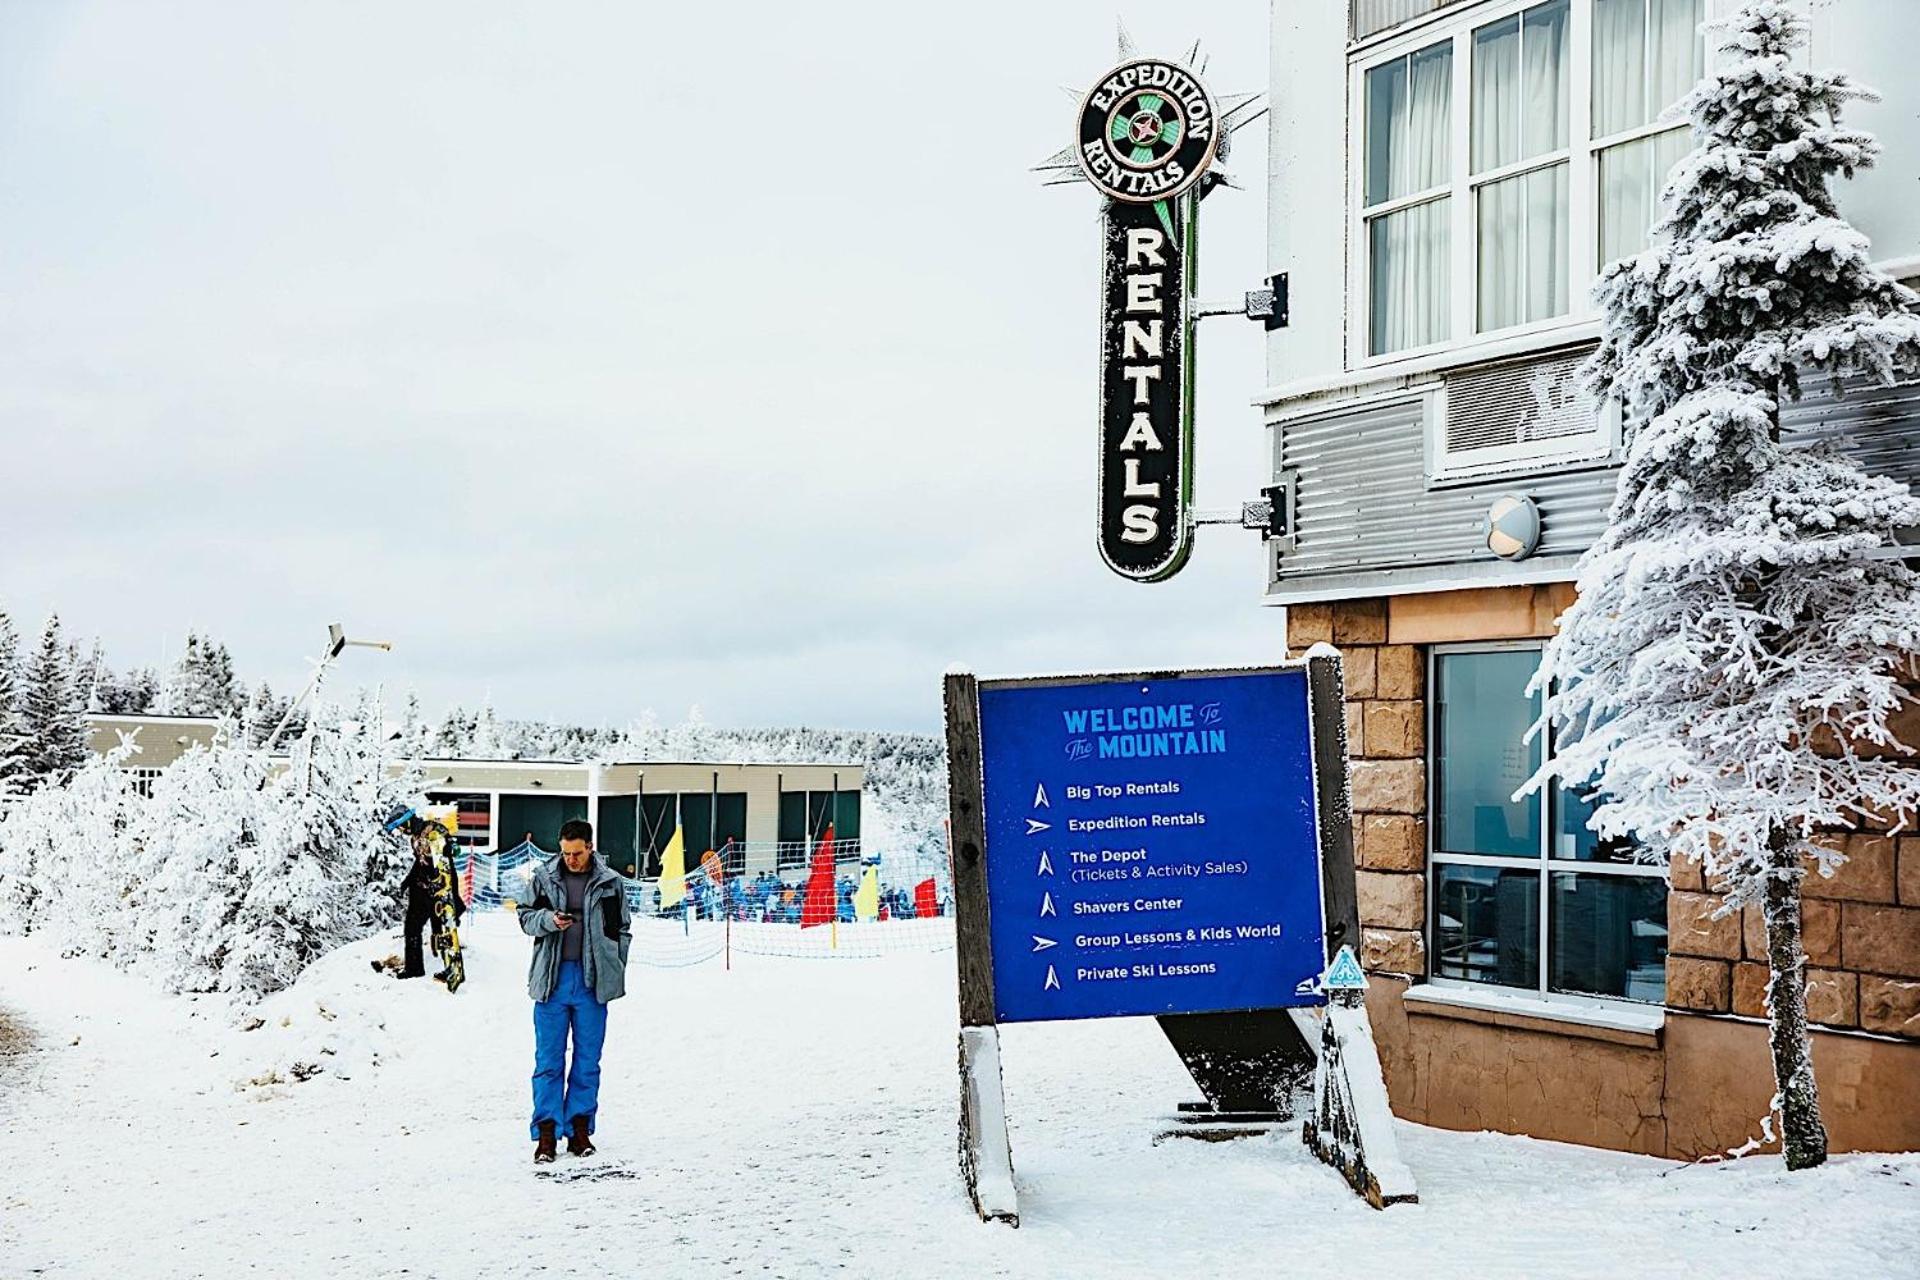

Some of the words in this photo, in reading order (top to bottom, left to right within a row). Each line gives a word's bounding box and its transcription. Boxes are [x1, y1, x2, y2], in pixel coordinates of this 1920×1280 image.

[1091, 65, 1212, 141] EXPEDITION
[1083, 138, 1185, 194] RENTALS
[1119, 228, 1167, 544] RENTALS
[1063, 704, 1195, 734] WELCOME
[1200, 702, 1223, 726] To
[1065, 738, 1094, 761] The
[1098, 730, 1227, 759] MOUNTAIN
[1067, 786, 1091, 800] Big
[1095, 785, 1122, 798] Top
[1126, 781, 1180, 795] Rentals
[1068, 816, 1147, 832] Expedition
[1152, 812, 1205, 827] Rentals
[1070, 852, 1097, 864] The
[1102, 849, 1147, 863] Depot
[1071, 868, 1128, 883] (Tickets
[1131, 866, 1142, 879] &
[1147, 863, 1200, 880] Activity
[1205, 861, 1248, 874] Sales)
[1073, 901, 1130, 914] Shavers
[1134, 898, 1182, 911] Center
[1076, 934, 1121, 947] Group
[1125, 931, 1182, 945] Lessons
[1186, 929, 1196, 941] &
[1200, 927, 1232, 940] Kids
[1236, 924, 1281, 937] World
[1077, 966, 1128, 980] Private
[1132, 964, 1155, 977] Ski
[1159, 962, 1216, 976] Lessons
